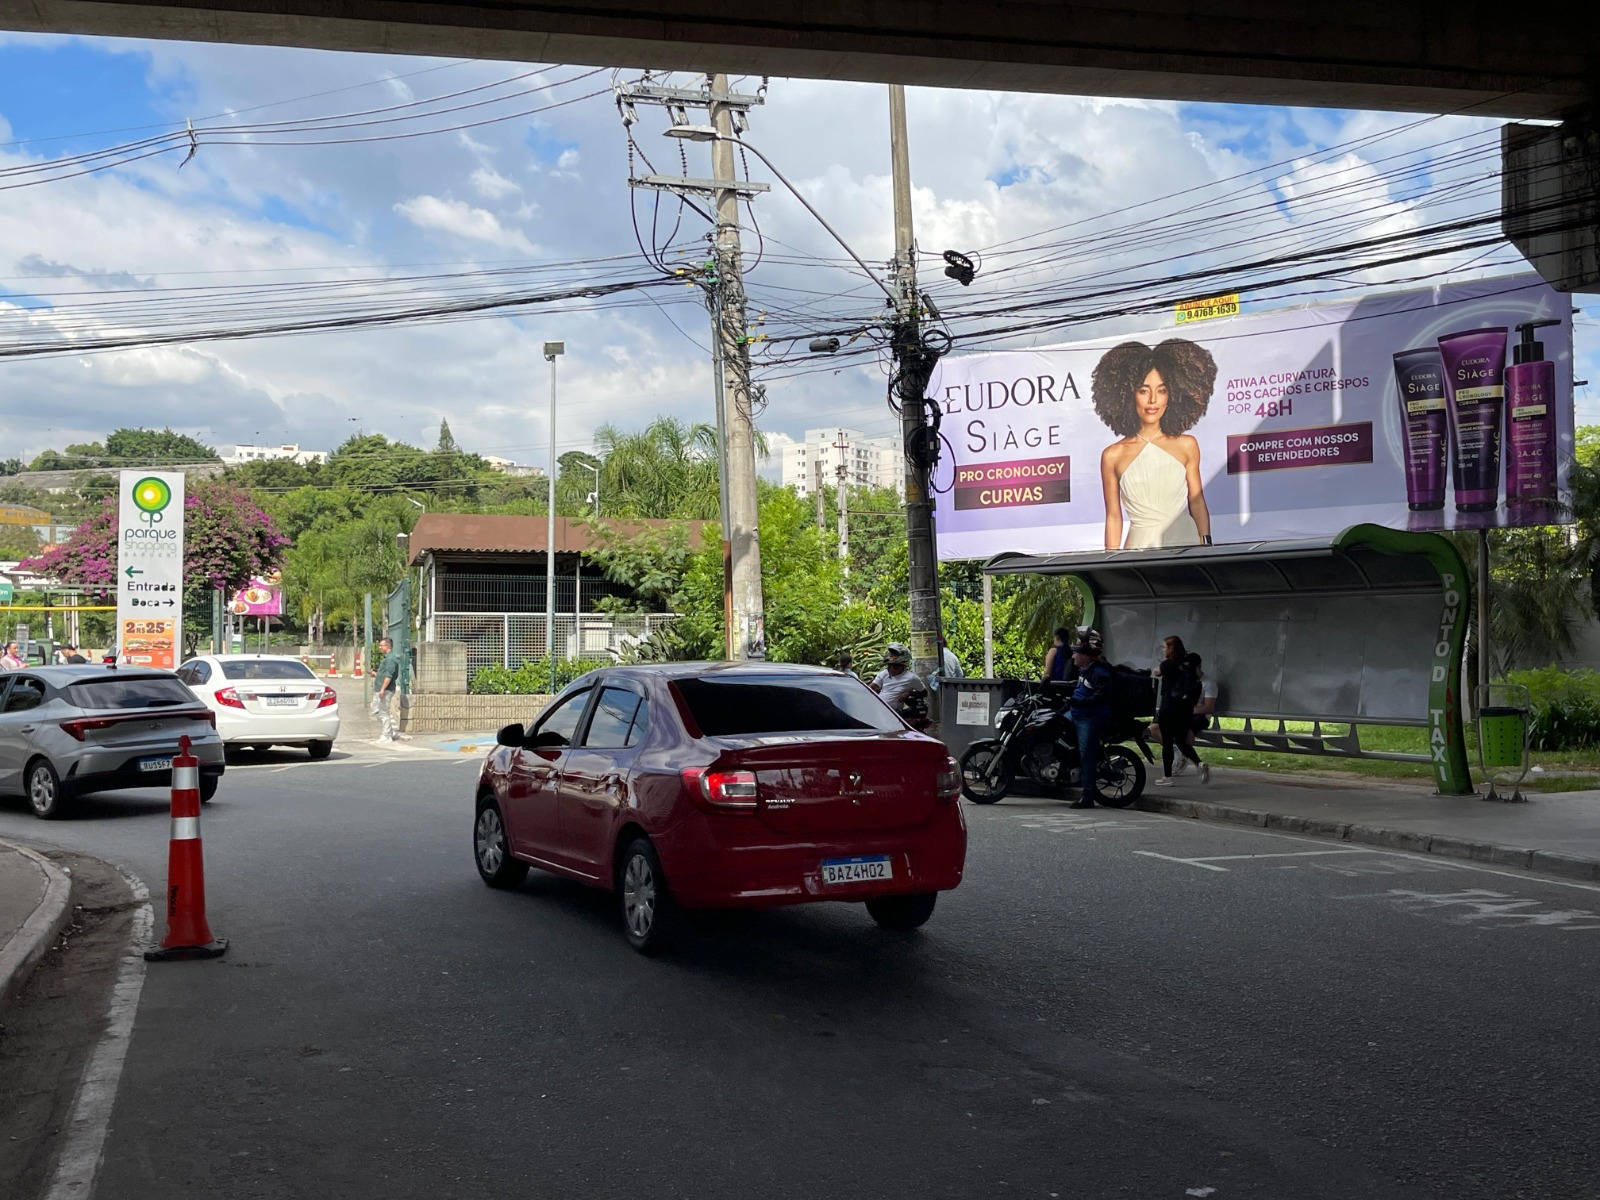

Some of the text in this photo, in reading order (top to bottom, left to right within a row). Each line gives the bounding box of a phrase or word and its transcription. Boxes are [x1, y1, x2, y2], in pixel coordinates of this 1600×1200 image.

[1179, 299, 1212, 310] ANUNCIE
[1187, 303, 1237, 319] 9.4768-1639
[1461, 357, 1490, 366] EUDORA
[1227, 368, 1337, 390] ATIVA A CURVATURA
[1411, 373, 1437, 381] EUDORA
[943, 372, 1081, 414] EUDORA
[1227, 377, 1369, 402] DOS CACHOS E CRESPOS
[1228, 399, 1293, 418] POR 48H
[1240, 433, 1359, 452] COMPRE COM NOSSOS
[1258, 447, 1340, 463] REVENDEDORES
[960, 463, 1065, 482] PRO CRONOLOGY
[980, 486, 1043, 505] CURVAS
[125, 528, 176, 542] parque
[125, 539, 177, 553] shopping
[128, 581, 176, 591] Entrada
[132, 598, 160, 606] Doca
[126, 622, 135, 634] 2
[146, 622, 165, 634] 25
[1430, 574, 1459, 781] PONTO D TAXI
[828, 864, 885, 882] BAZ4H02
